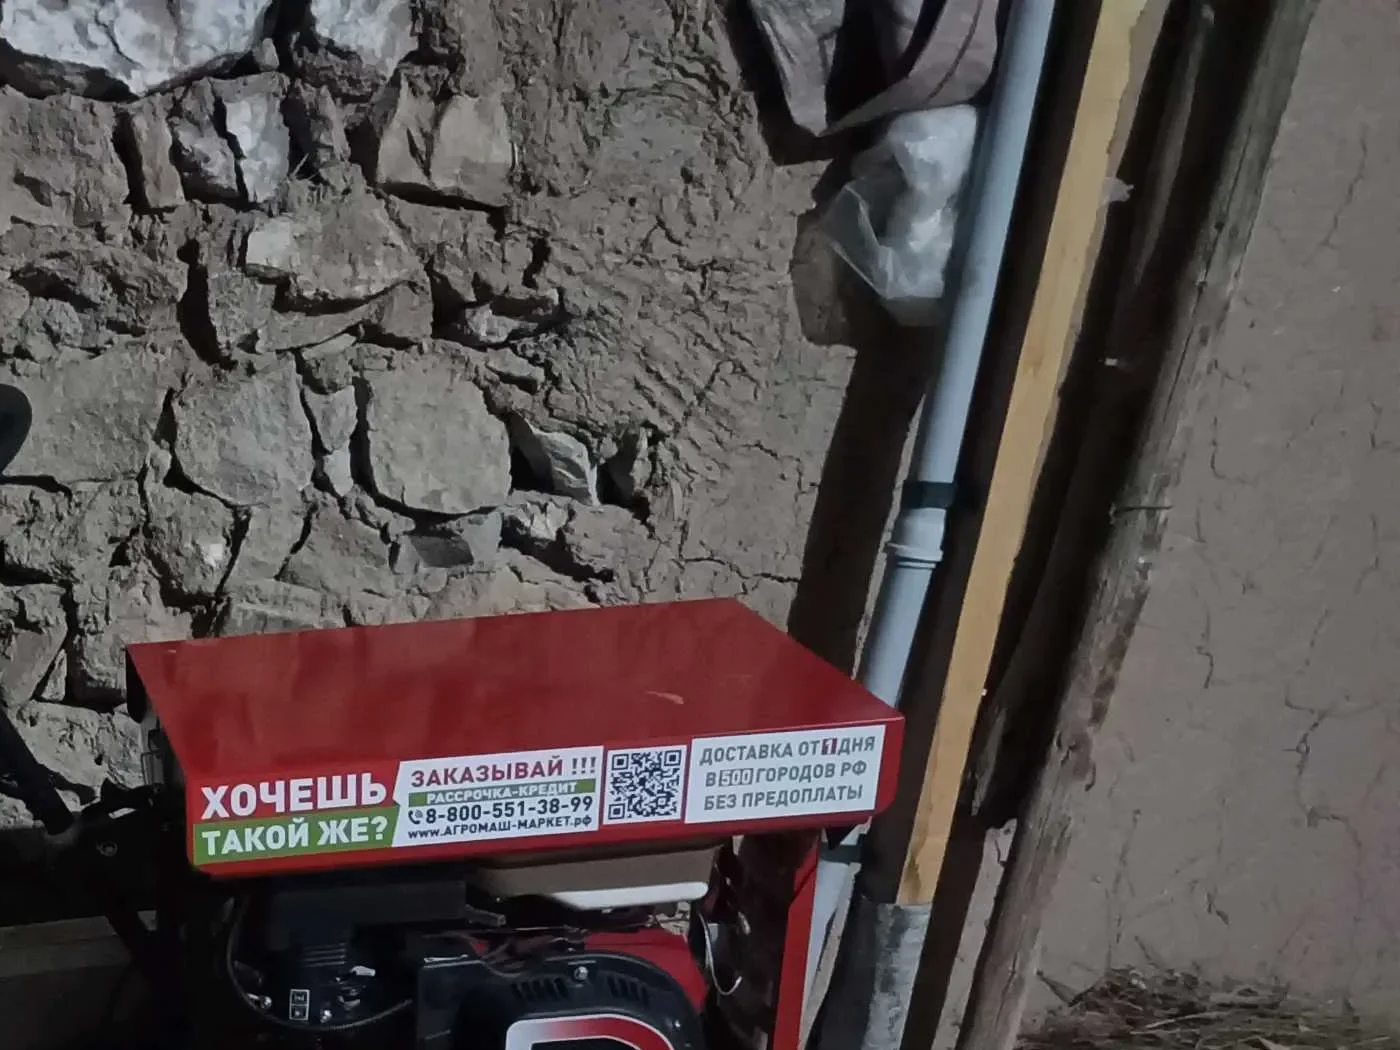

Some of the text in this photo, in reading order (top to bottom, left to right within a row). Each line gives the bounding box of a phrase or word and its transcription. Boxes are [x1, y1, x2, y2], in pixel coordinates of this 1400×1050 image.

[700, 742, 793, 766] ДОСТАВКА
[798, 740, 822, 757] ОТ
[837, 736, 876, 755] ДНЯ
[411, 755, 563, 787] ЗАКАЗЫВАЙ
[705, 760, 867, 787] В 500 ГОРОДОВ РФ
[201, 773, 387, 820] ХОЧЕШЬ
[427, 782, 577, 804] РАССРОЧКА-КРЕДИТ
[704, 784, 863, 811] БЕЗ ПРЕДОПЛАТЫ
[426, 796, 593, 824] 8-800-551-38-99
[202, 816, 388, 856] ТАКОЙ ЖЕ?
[408, 815, 592, 839] www.АГРОМАШ-МАРКЕТ.рф
